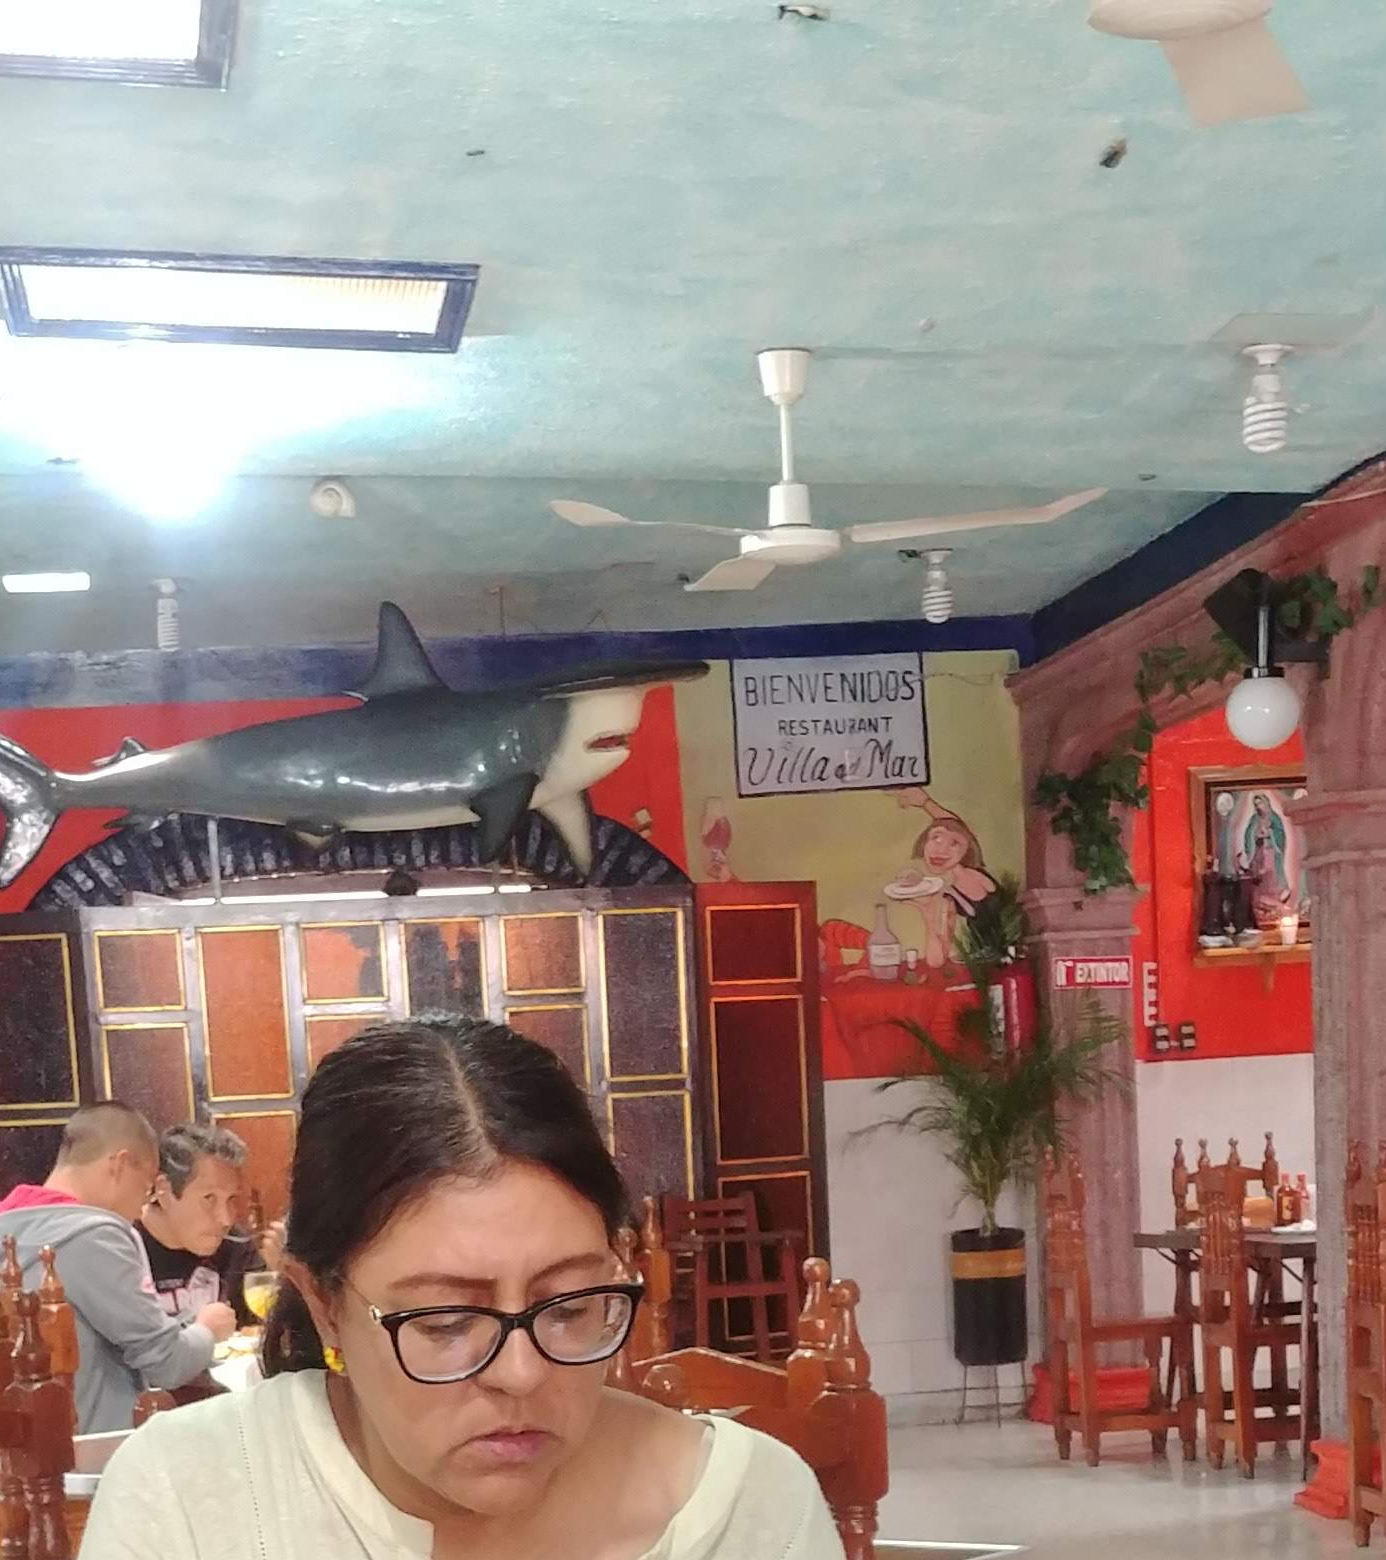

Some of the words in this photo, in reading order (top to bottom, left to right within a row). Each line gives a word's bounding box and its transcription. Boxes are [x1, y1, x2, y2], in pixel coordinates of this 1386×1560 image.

[743, 670, 916, 707] BIENVENIDOS
[778, 716, 893, 737] RESTAURANT
[747, 746, 830, 786] Villa
[865, 738, 919, 779] Mar
